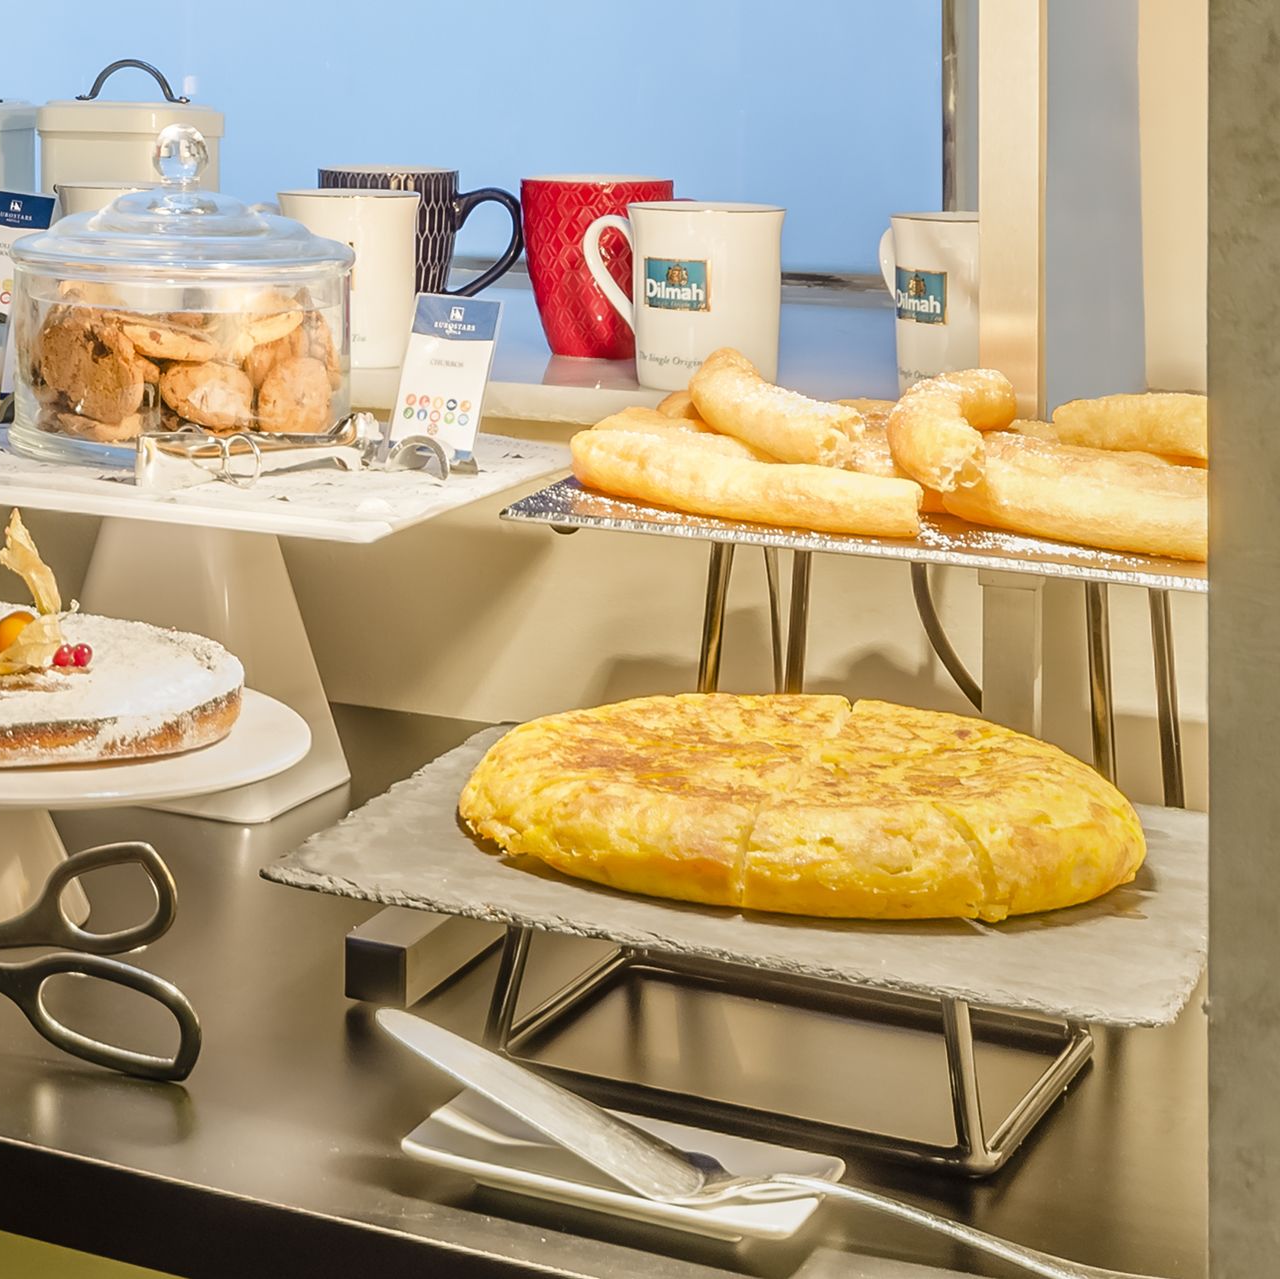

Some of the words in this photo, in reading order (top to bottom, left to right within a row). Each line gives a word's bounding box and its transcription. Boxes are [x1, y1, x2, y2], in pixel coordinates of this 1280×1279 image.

[646, 278, 704, 300] Dilmah
[896, 289, 940, 314] Dilmah
[434, 321, 476, 332] EUROSTARS
[430, 359, 464, 368] CHURROS
[639, 350, 648, 360] The
[649, 353, 670, 366] Single
[672, 356, 704, 368] Origin
